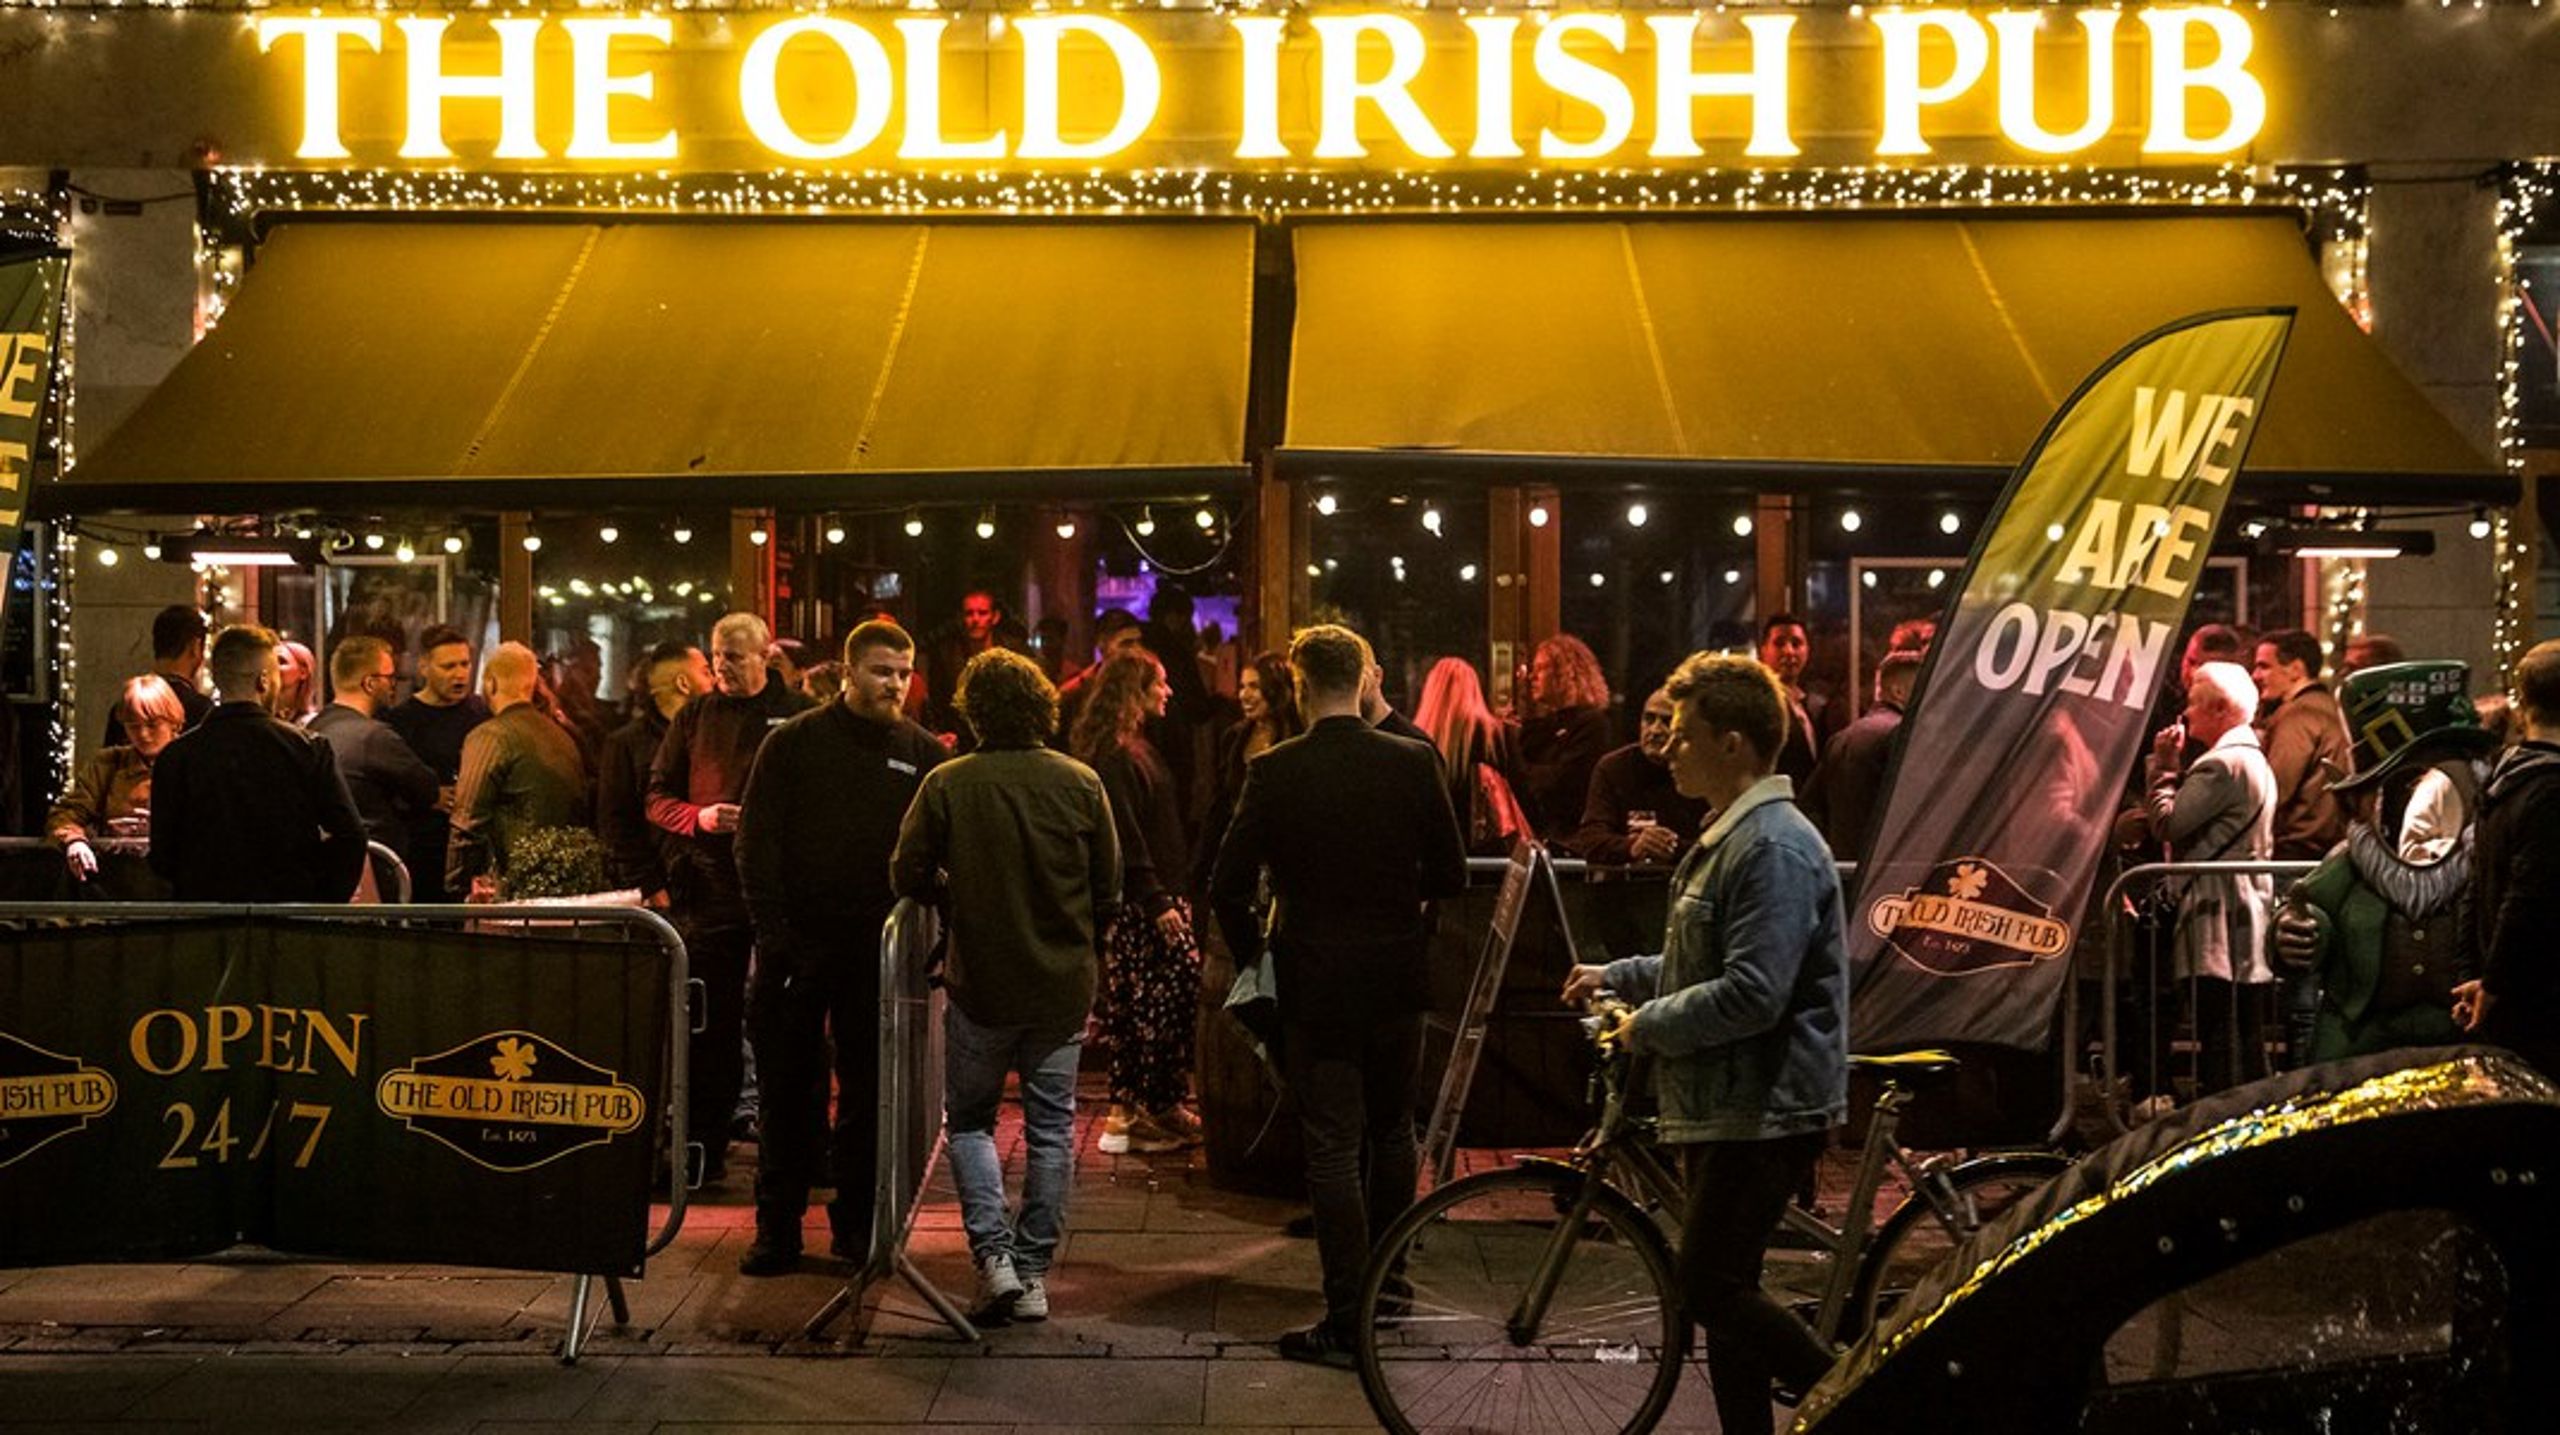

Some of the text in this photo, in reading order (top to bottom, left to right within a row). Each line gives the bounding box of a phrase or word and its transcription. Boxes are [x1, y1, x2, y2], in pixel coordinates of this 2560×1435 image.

[259, 8, 2266, 159] THE OLD IRISH PUB
[2126, 387, 2254, 486] WE
[2055, 498, 2211, 598] ARE
[1975, 602, 2171, 710] OPEN
[1952, 905, 2013, 941] IRISH
[2015, 920, 2059, 948] PUB
[130, 1003, 369, 1078] OPEN
[0, 1080, 105, 1113] ISH PUB
[157, 1097, 333, 1169] 24/7
[389, 1079, 633, 1121] THE OLD IRISH PUB
